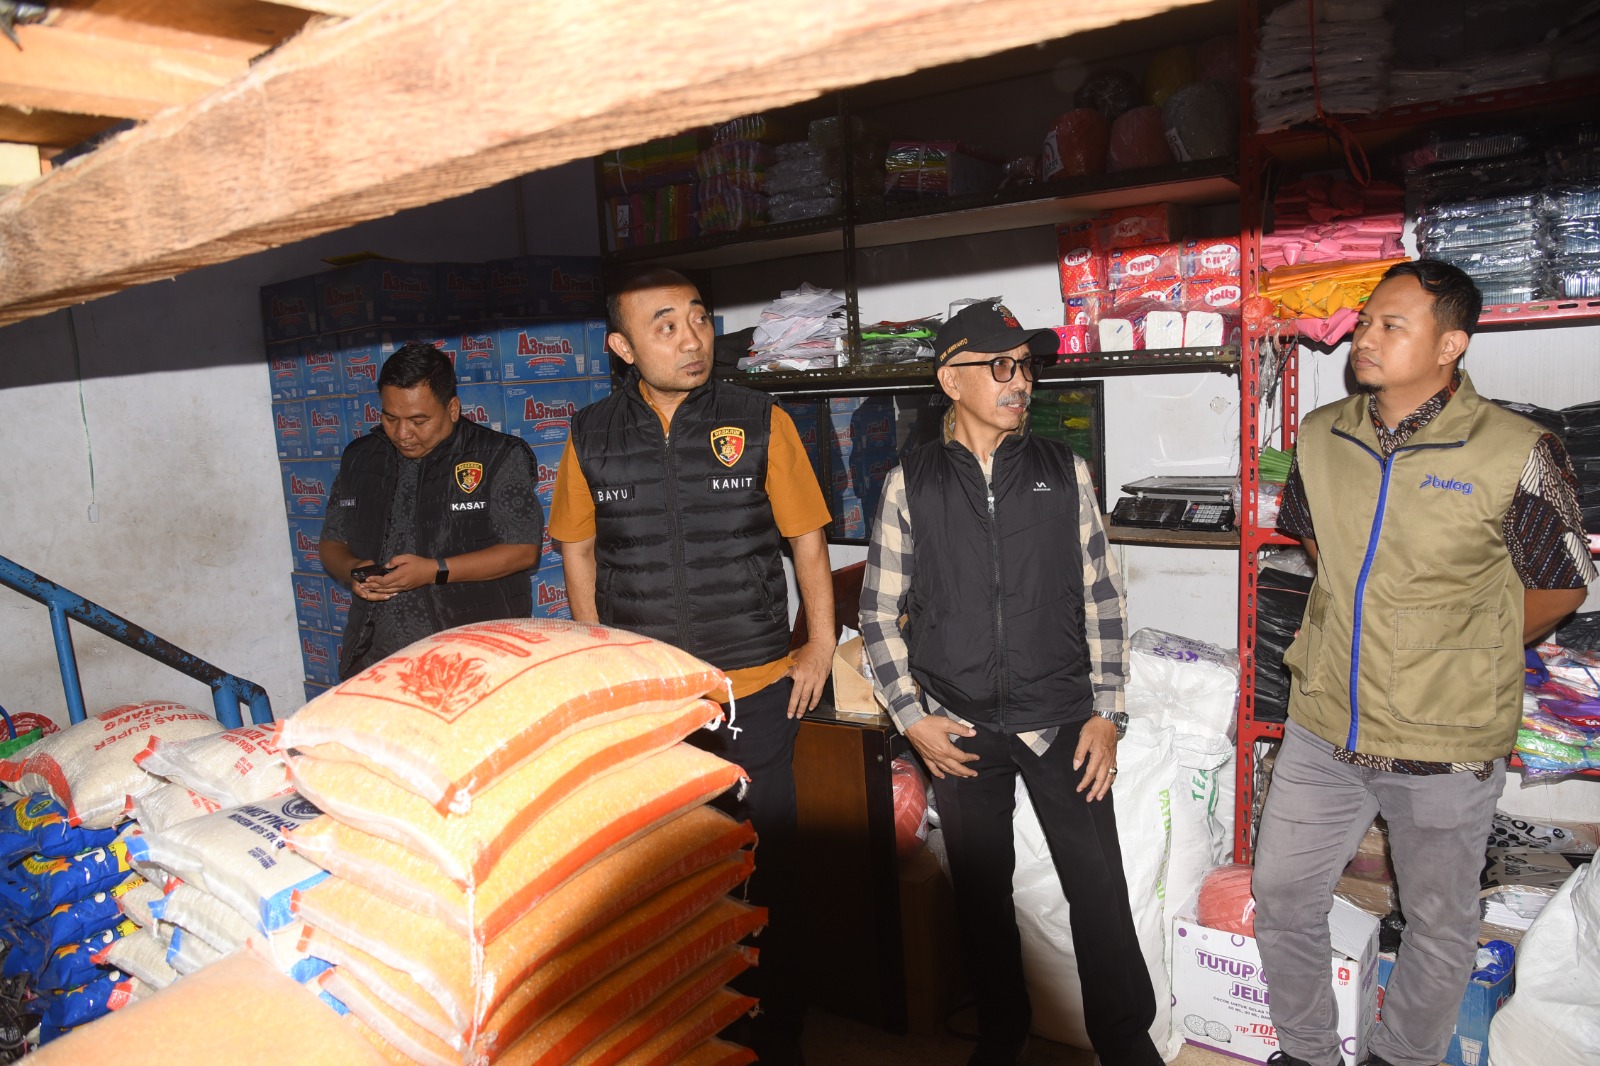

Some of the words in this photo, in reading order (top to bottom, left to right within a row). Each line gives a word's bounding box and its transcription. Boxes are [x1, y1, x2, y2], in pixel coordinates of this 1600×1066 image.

[1209, 289, 1237, 304] jolly
[713, 477, 752, 491] KANIT
[1433, 476, 1473, 495] bulog
[597, 489, 629, 502] BAYU
[452, 501, 486, 511] KASAT
[154, 713, 210, 725] BERAS
[94, 722, 151, 751] SUPER
[1197, 951, 1255, 979] TUTUP
[1230, 1001, 1247, 1009] UNTUK
[1248, 1006, 1264, 1014] GELAS
[1234, 1025, 1249, 1034] Tip
[1250, 1023, 1278, 1036] TOP
[1263, 1039, 1276, 1047] Lid
